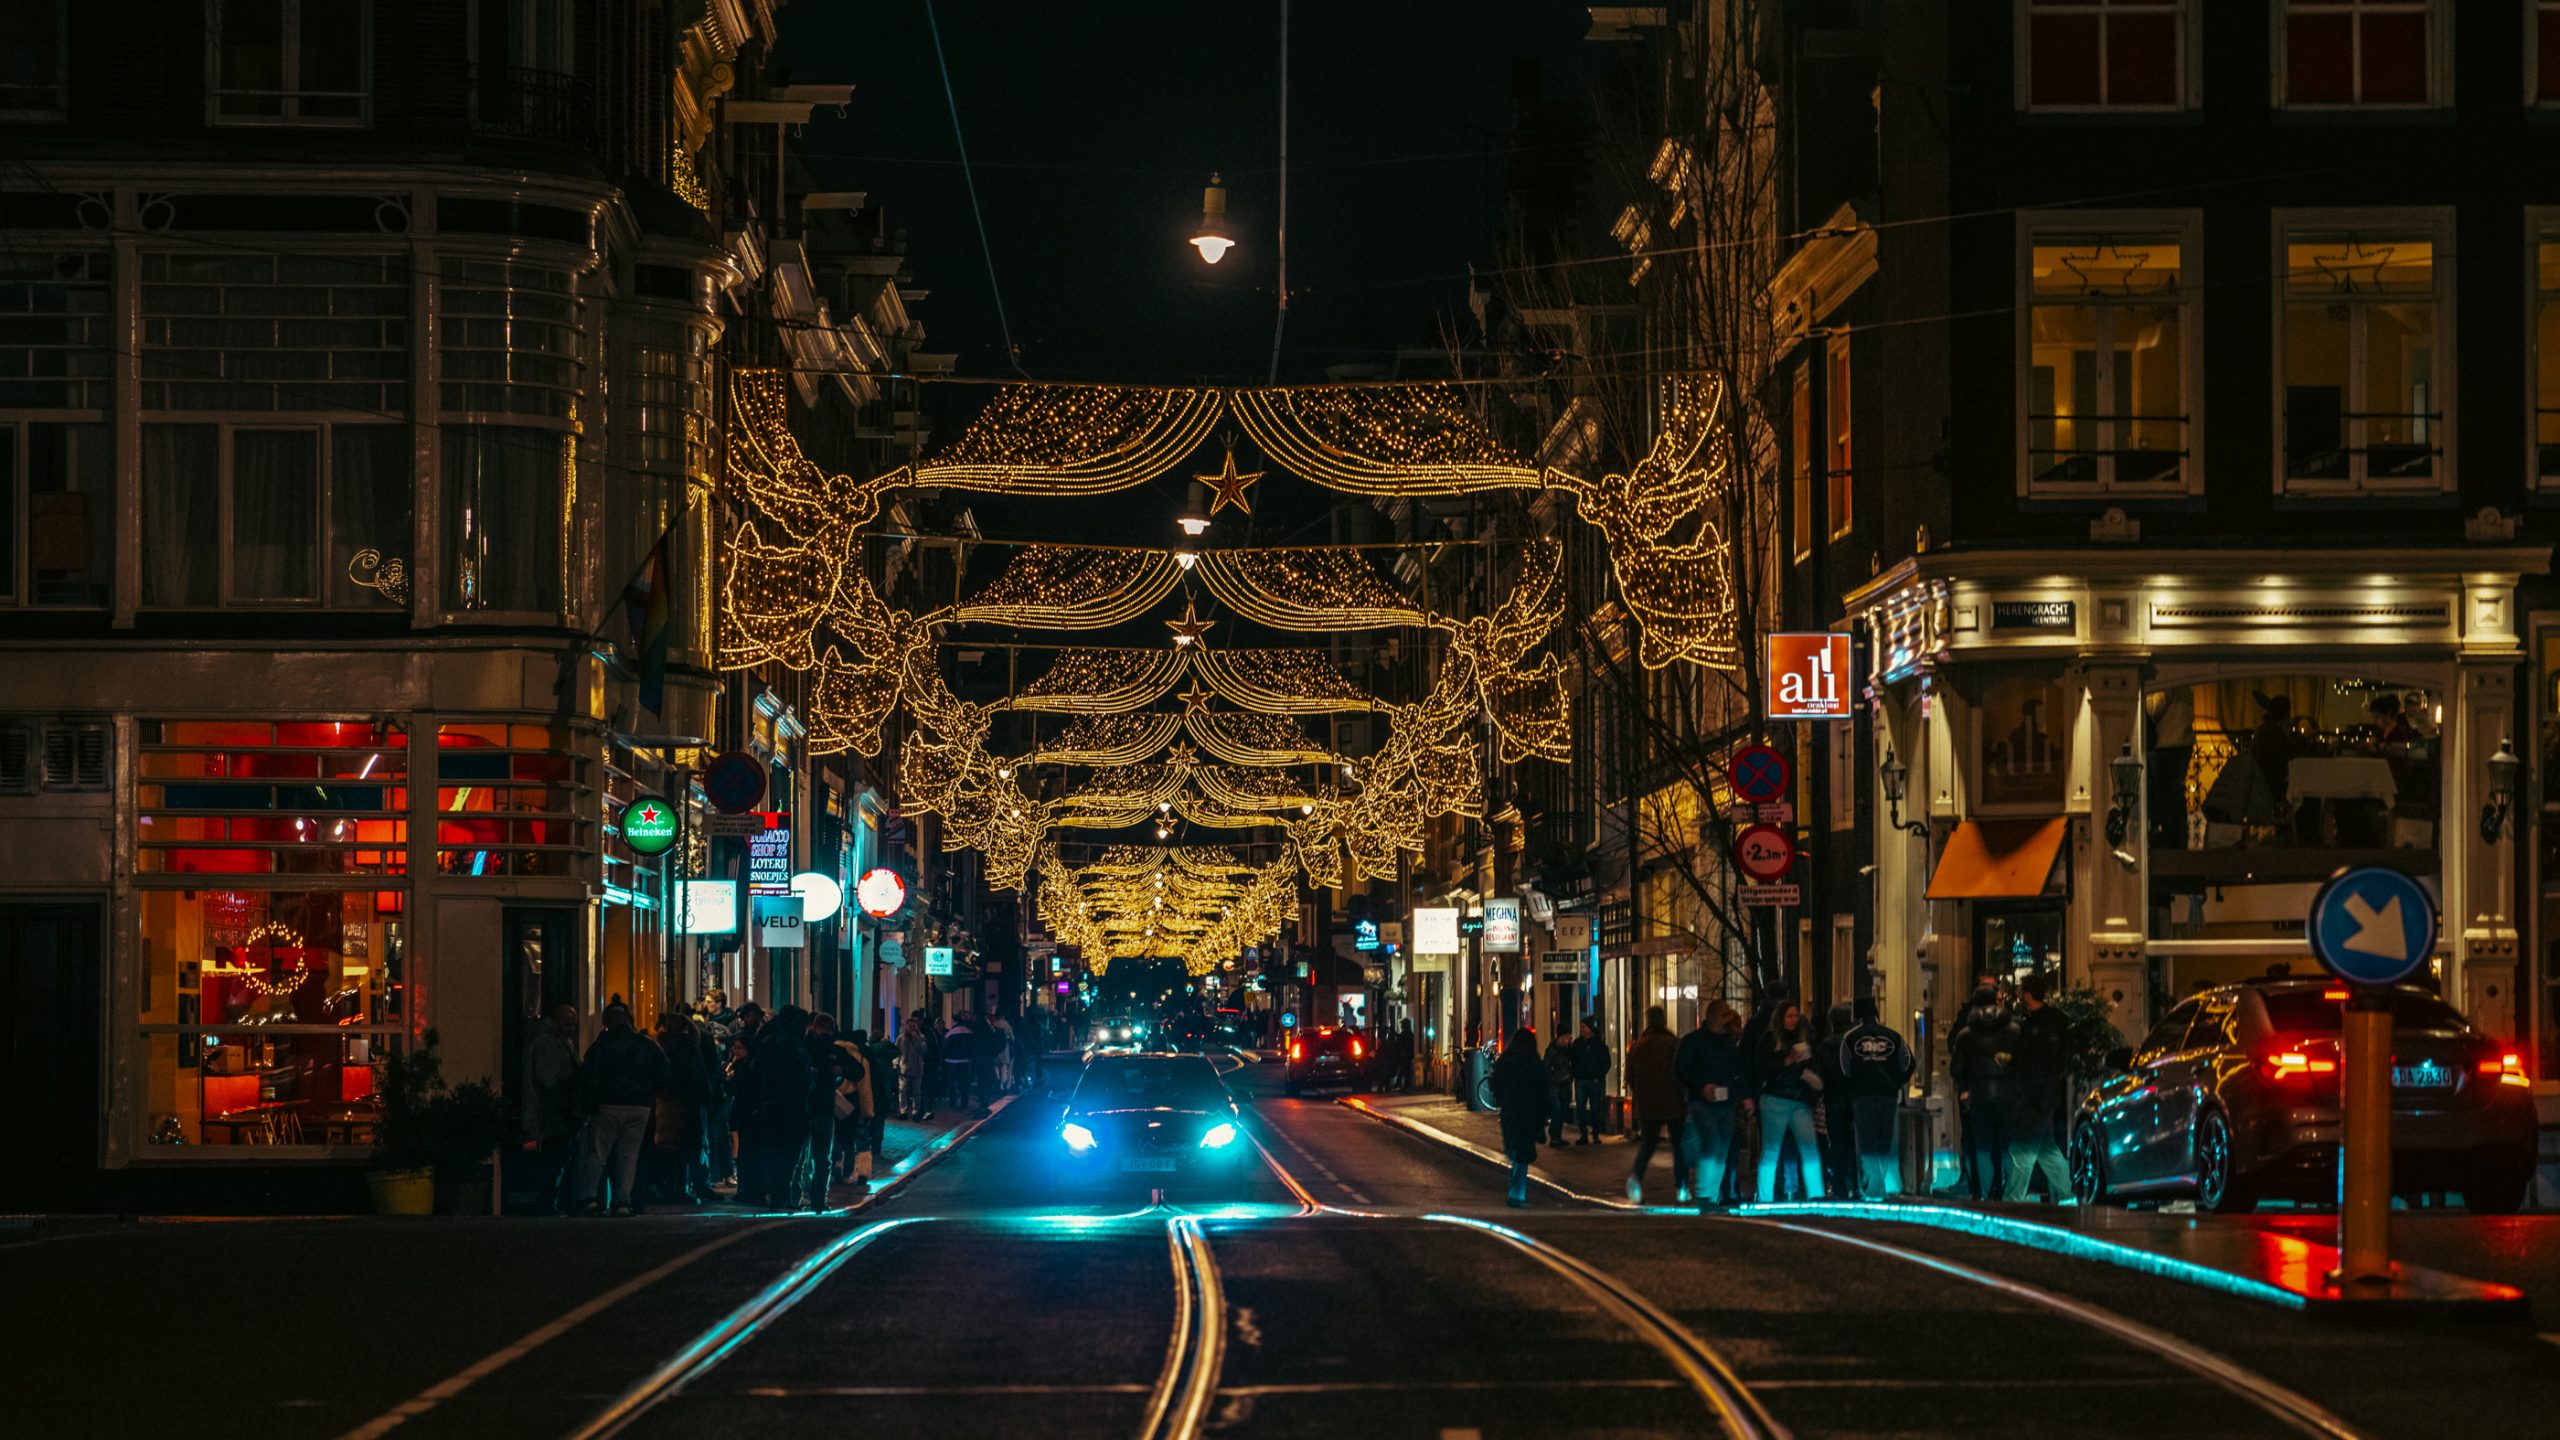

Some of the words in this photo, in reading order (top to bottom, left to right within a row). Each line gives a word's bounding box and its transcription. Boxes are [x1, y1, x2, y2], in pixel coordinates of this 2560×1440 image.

[1997, 603, 2069, 616] HERENGRACHT
[2032, 616, 2070, 625] (CENTRUM)
[1779, 655, 1839, 703] ali
[628, 827, 673, 836] Heineken
[751, 844, 776, 857] SHOP
[751, 858, 787, 871] LOTERIJ
[750, 871, 788, 883] SNOEPJES
[1486, 907, 1518, 923] MEGHNA
[758, 916, 799, 928] VELD
